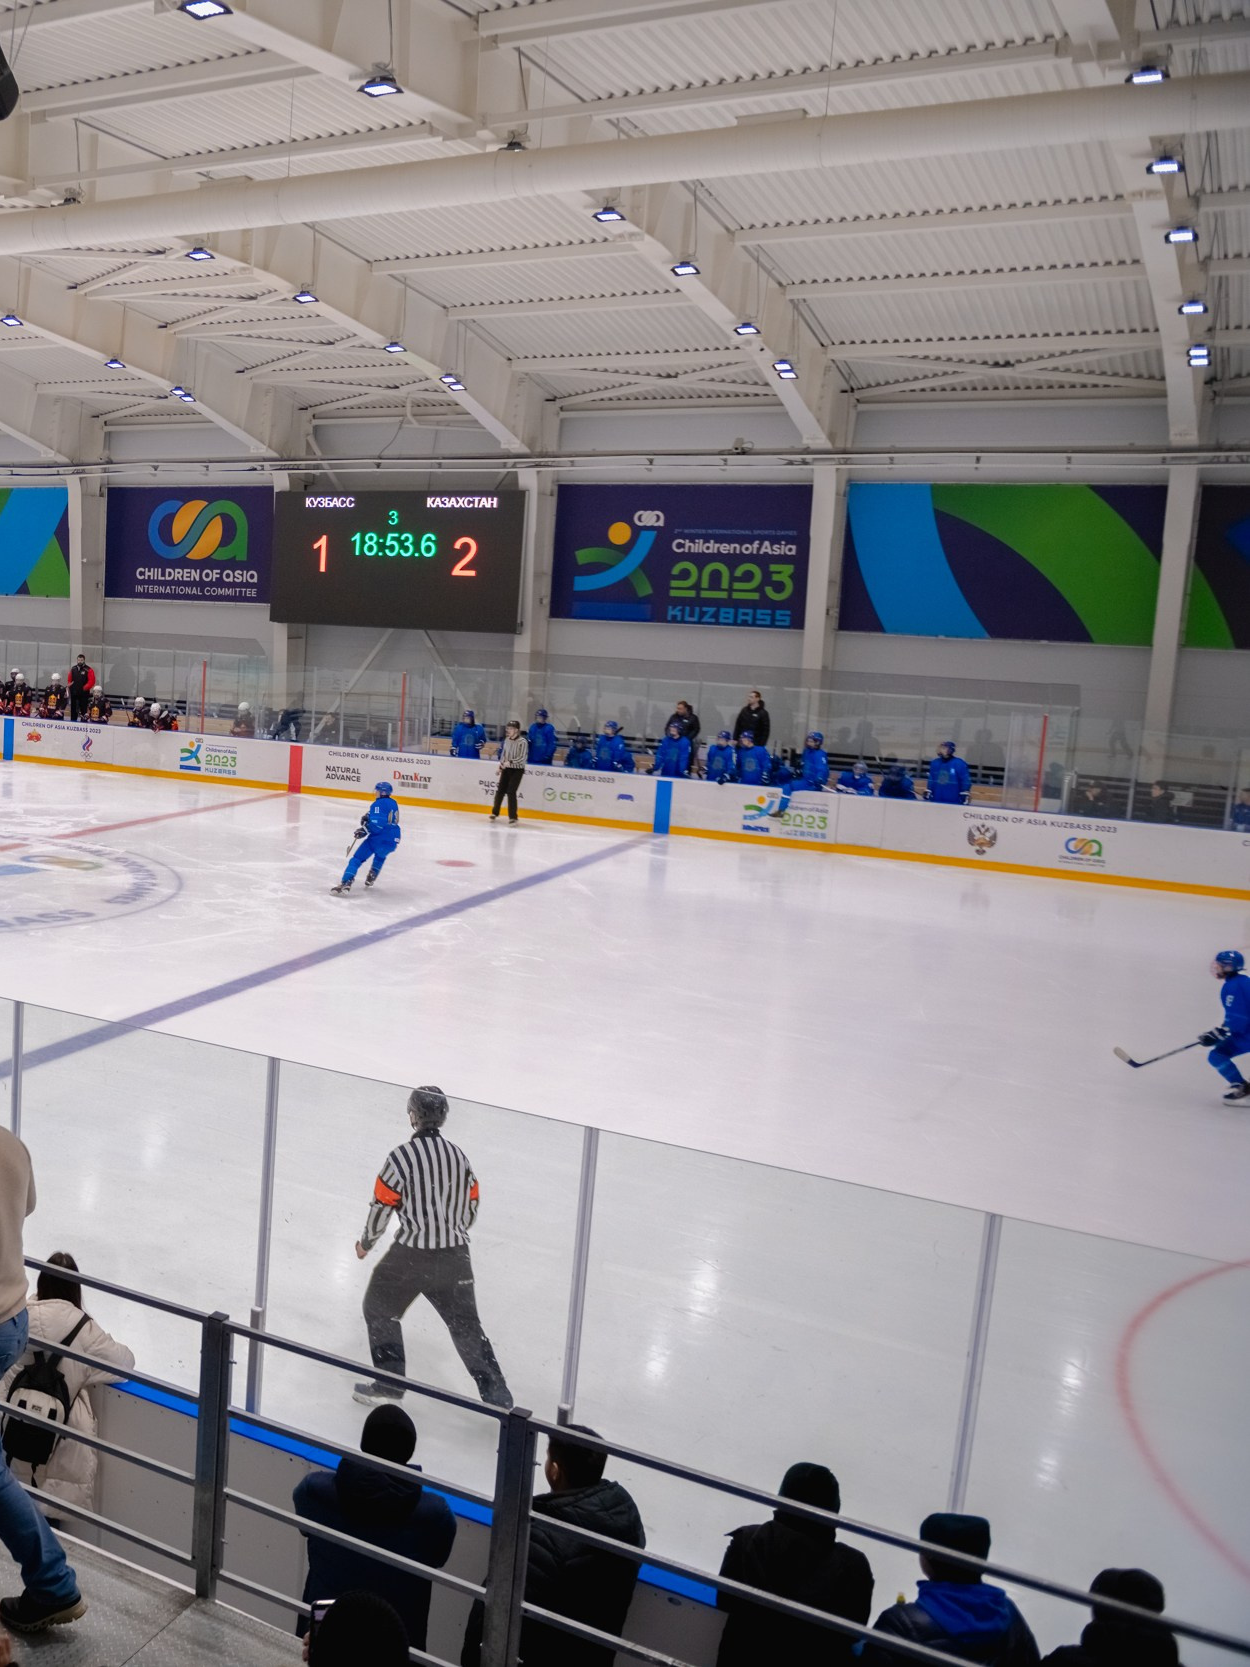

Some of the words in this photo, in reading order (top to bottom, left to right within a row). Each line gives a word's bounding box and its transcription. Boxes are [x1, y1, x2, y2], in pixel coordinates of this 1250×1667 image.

[305, 497, 355, 508] КУЗБАСС
[426, 497, 498, 508] КАЗАХСТАН
[388, 510, 399, 525] 3
[351, 532, 437, 557] 18:53.6
[671, 539, 740, 554] Children
[741, 540, 760, 554] of
[760, 541, 797, 555] Asia
[312, 534, 328, 573] 1
[451, 536, 477, 577] 2
[136, 567, 200, 582] CHILDREN
[202, 569, 221, 582] OF
[669, 561, 794, 601] 2023
[135, 585, 202, 595] INTERNATIONAL
[204, 587, 257, 596] COMMITTEE
[667, 605, 791, 626] KUZBASS
[67, 725, 89, 733] KUZBASS
[205, 754, 237, 768] 2023
[328, 751, 359, 759] CHILDREN
[205, 767, 237, 775] KUZBASS
[325, 765, 361, 775] NATURAL
[325, 773, 361, 782] ADVANCE
[546, 771, 562, 779] ASIA
[564, 773, 596, 782] KUZBASS
[597, 776, 615, 784] 2023
[781, 812, 828, 830] 2023
[963, 811, 1009, 822] CHILDREN
[1026, 818, 1047, 826] ASIA
[1050, 820, 1092, 831] KUZBASS
[1094, 825, 1118, 834] 2023
